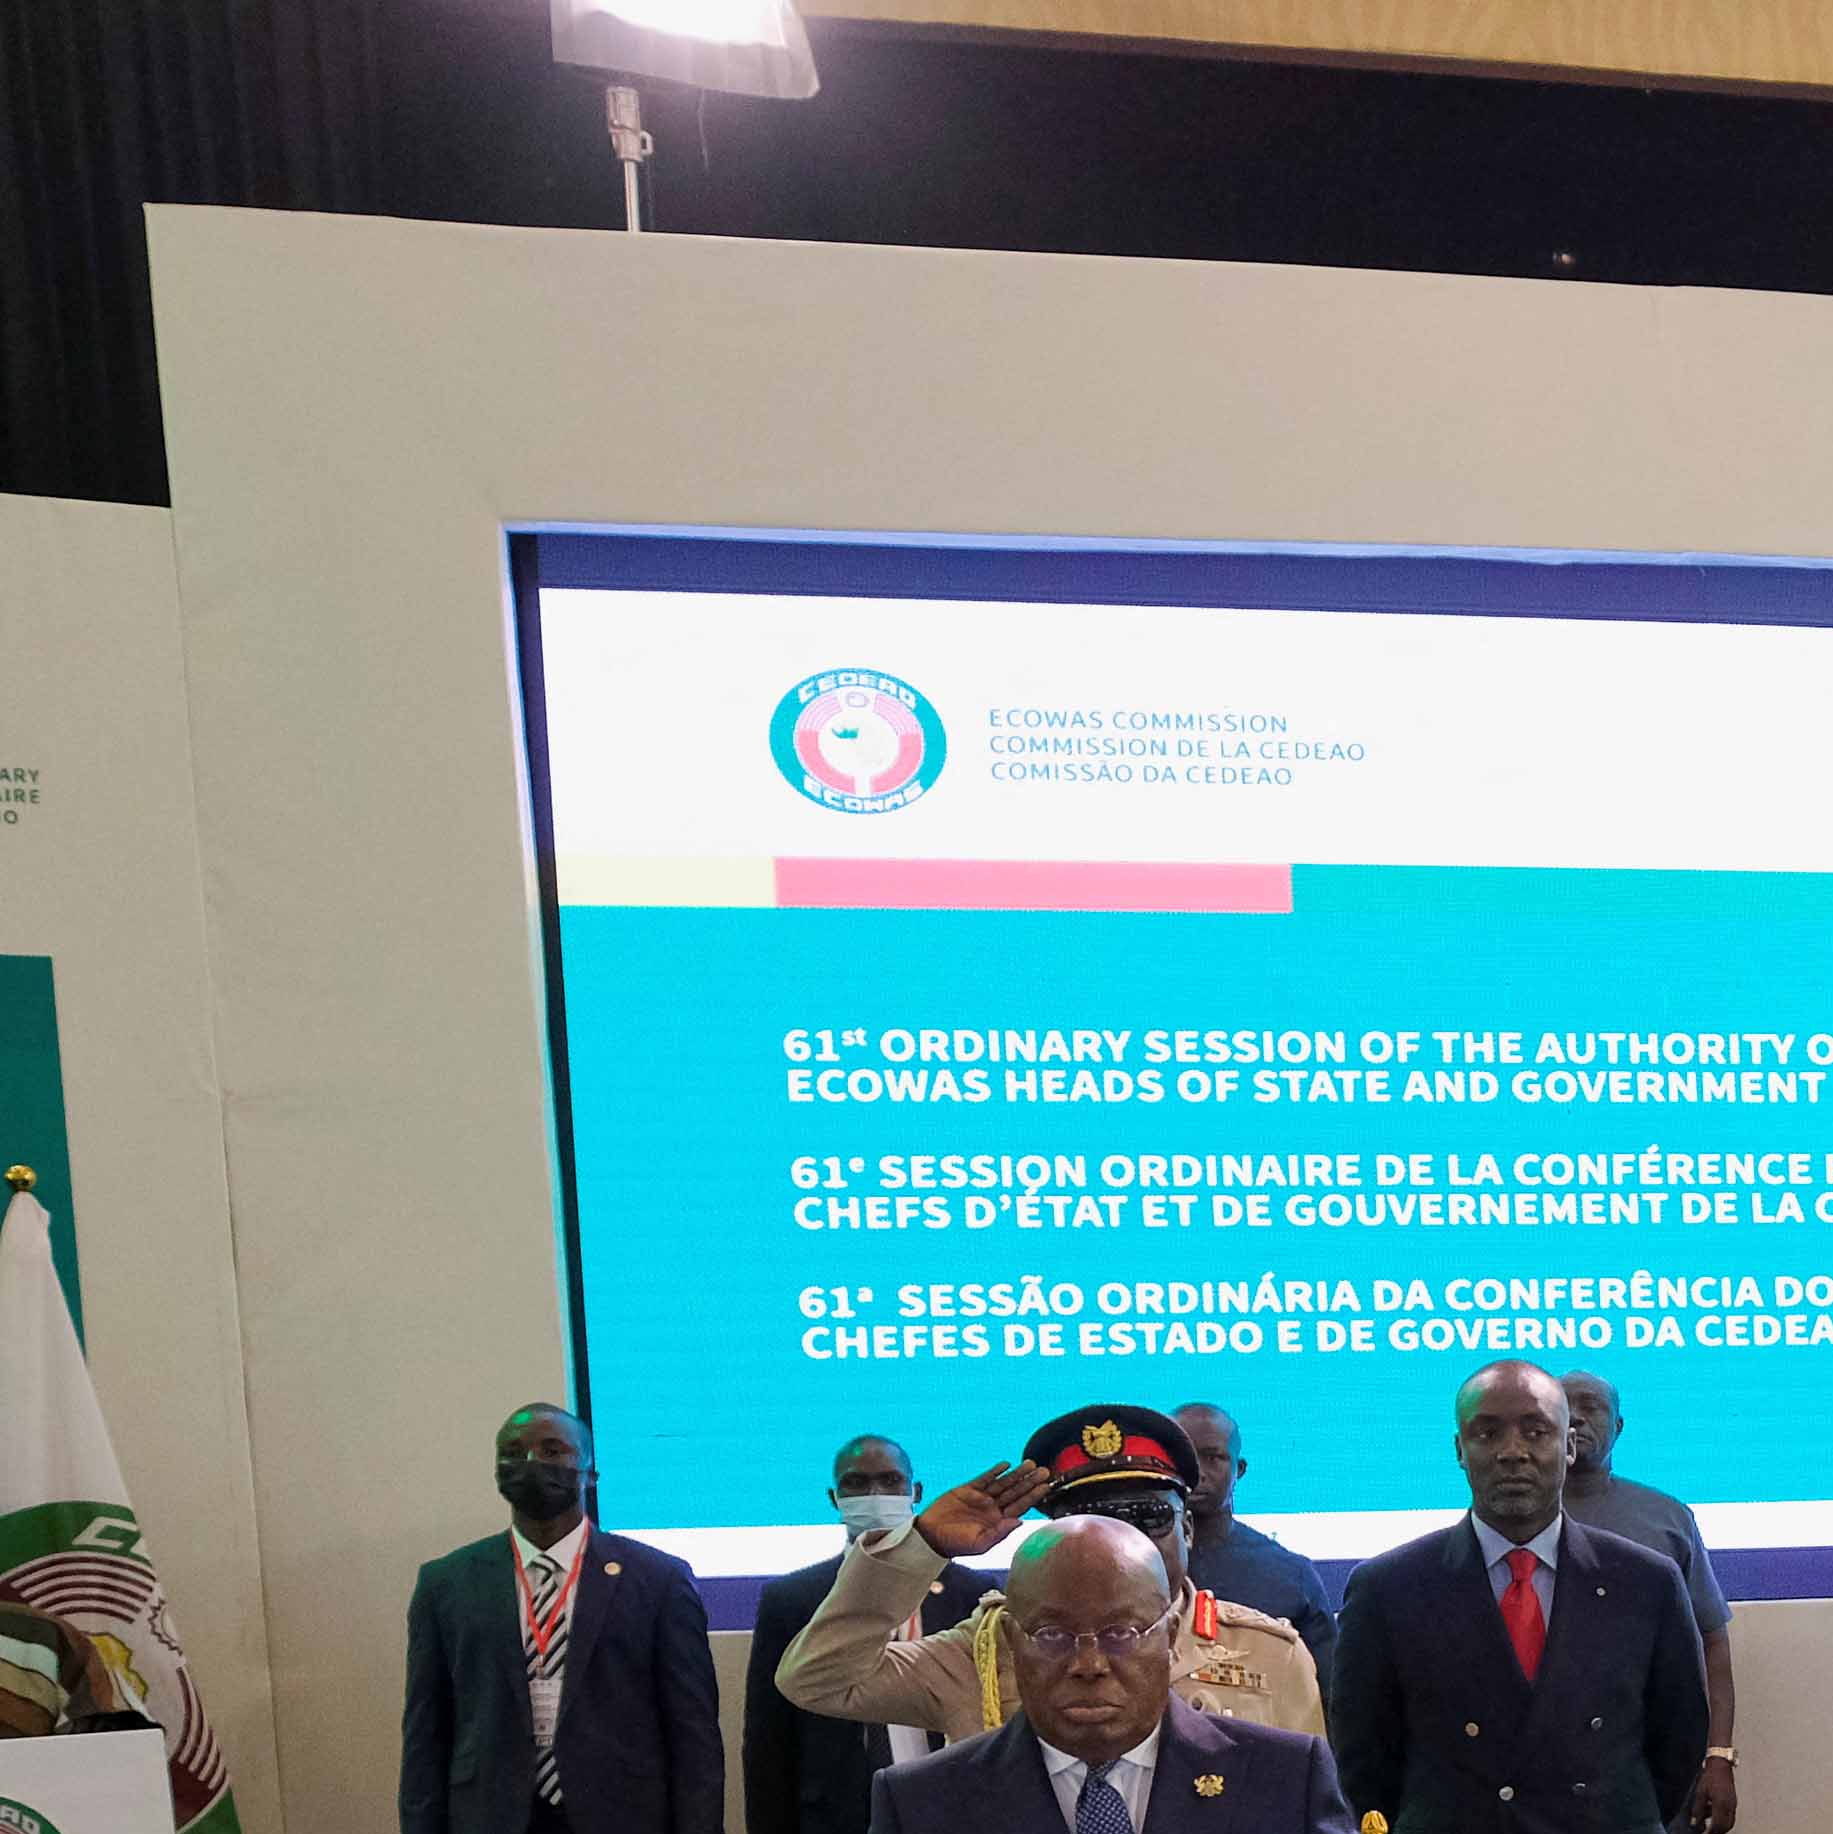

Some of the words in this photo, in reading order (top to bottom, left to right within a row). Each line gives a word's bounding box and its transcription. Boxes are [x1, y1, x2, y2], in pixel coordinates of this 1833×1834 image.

[990, 710, 1103, 730] ECOWAS
[1113, 712, 1288, 733] COMMISSION
[990, 736, 1168, 757] COMMISSION
[1178, 738, 1210, 758] DE
[1221, 739, 1251, 759] LA
[1260, 741, 1365, 761] CEDEAO
[991, 760, 1135, 782] COMISSÃO
[1144, 765, 1177, 783] DA
[1187, 766, 1292, 785] CEDEAO
[784, 1028, 866, 1061] 61st
[880, 1029, 1131, 1062] ORDINARY
[1144, 1030, 1345, 1063] SESSION
[1360, 1031, 1420, 1063] OF
[1433, 1032, 1523, 1063] THE
[1536, 1033, 1795, 1064] AUTHORITY
[788, 1069, 991, 1102] ECOWAS
[1005, 1070, 1164, 1102] HEADS
[1178, 1070, 1239, 1102] OF
[1254, 1070, 1391, 1102] STATE
[1403, 1071, 1498, 1102] AND
[1512, 1071, 1826, 1103] GOVERNMENT
[880, 1155, 1086, 1188] SESSION
[1101, 1155, 1361, 1187] ORDINAIRE
[1376, 1154, 1434, 1185] DE
[1448, 1154, 1503, 1185] LA
[1514, 1144, 1812, 1185] CONFÉRENCE
[794, 1197, 951, 1229] CHEFS
[1142, 1195, 1198, 1227] ET
[1213, 1195, 1272, 1226] DE
[1286, 1193, 1668, 1226] GOUVERNEMENT
[1682, 1193, 1738, 1223] DE
[1752, 1192, 1804, 1223] LA
[898, 1275, 1083, 1317] SESSÃO
[1098, 1272, 1361, 1314] ORDINÁRIA
[1374, 1280, 1433, 1312] DA
[1445, 1270, 1763, 1310] CONFERÊNCIA
[802, 1324, 990, 1359] CHEFES
[1004, 1324, 1064, 1356] DE
[1079, 1321, 1263, 1355] ESTADO
[1278, 1321, 1302, 1352] E
[1317, 1320, 1375, 1351] DE
[1389, 1317, 1612, 1350] GOVERNO
[1626, 1316, 1684, 1347] DA
